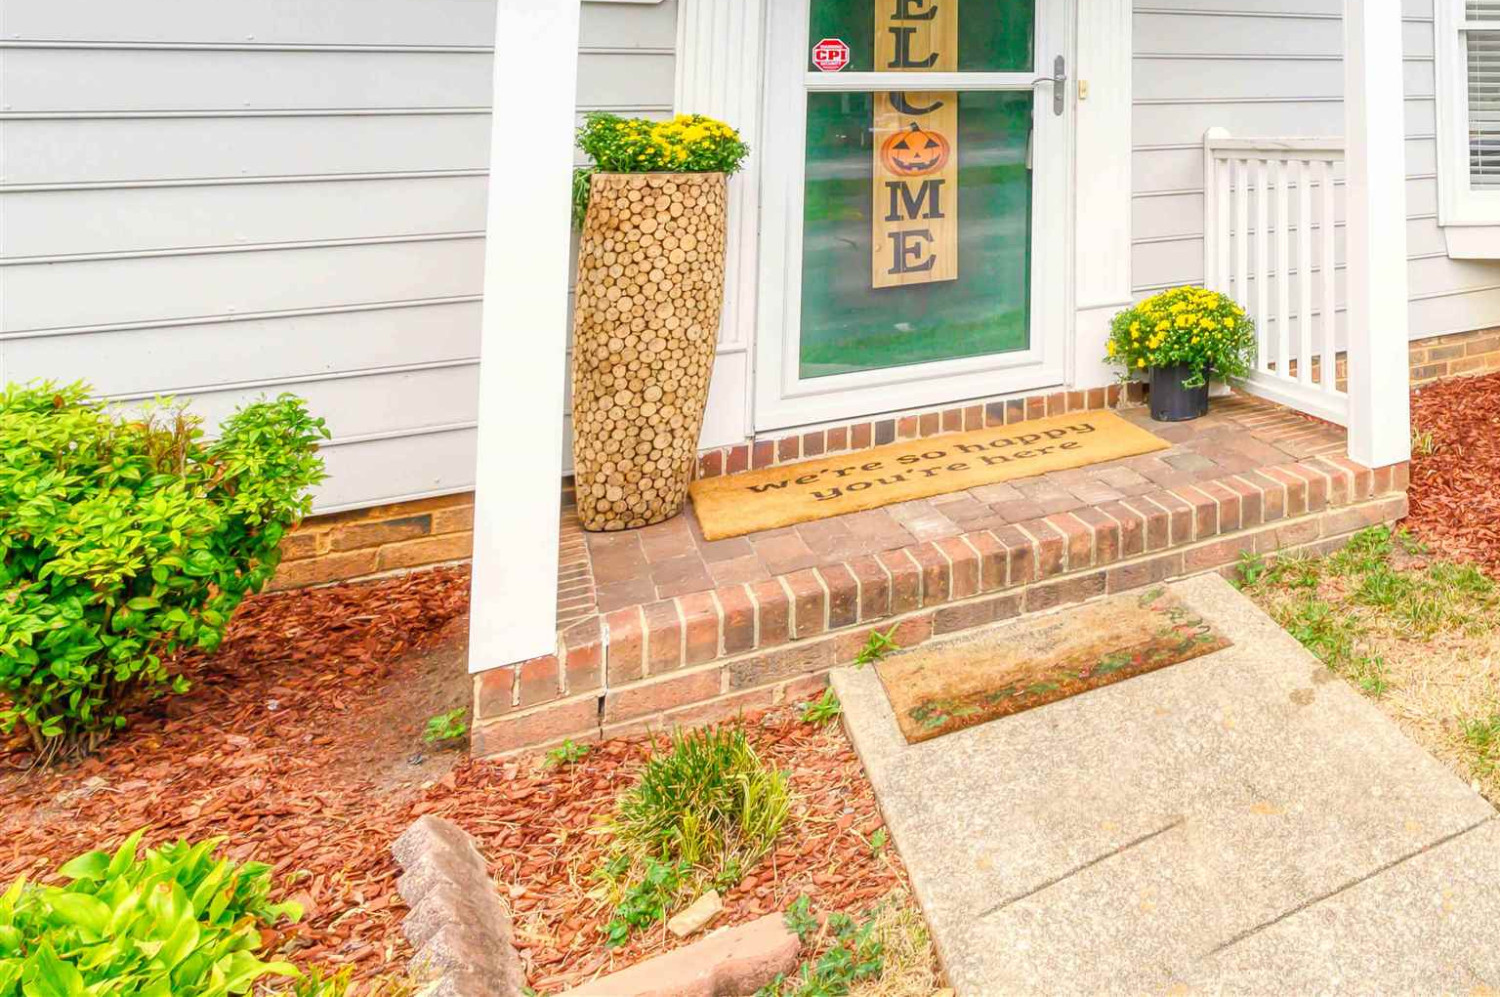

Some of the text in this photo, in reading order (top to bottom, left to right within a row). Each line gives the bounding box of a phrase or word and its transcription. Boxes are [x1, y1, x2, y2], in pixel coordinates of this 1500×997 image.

[815, 50, 846, 61] CPI
[746, 422, 1096, 493] we're so happy
[810, 440, 1082, 501] you're here
